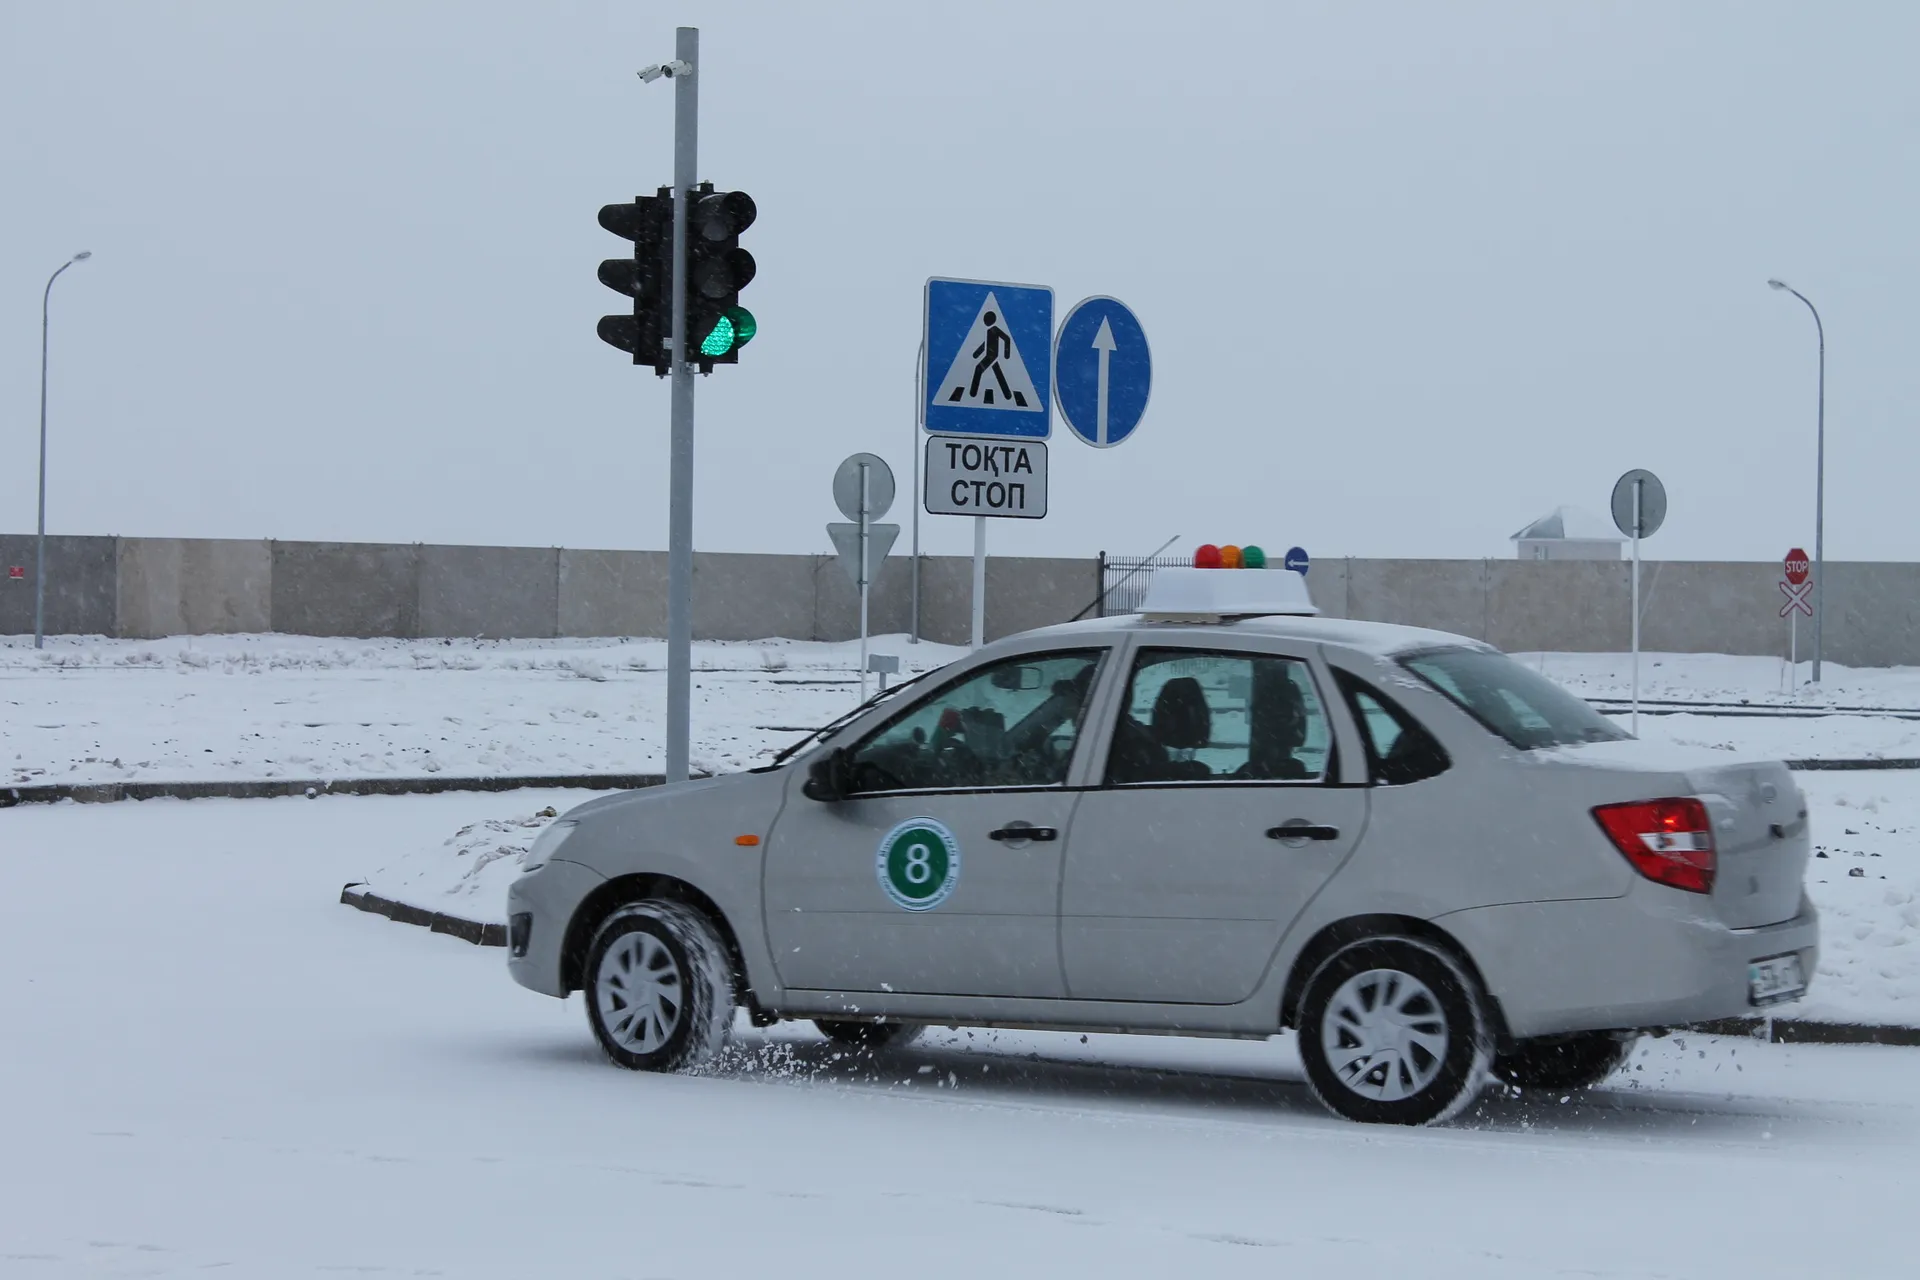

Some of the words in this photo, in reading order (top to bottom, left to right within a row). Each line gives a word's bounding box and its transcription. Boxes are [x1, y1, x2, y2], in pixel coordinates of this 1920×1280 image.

[945, 443, 1033, 477] ТОҚТА
[951, 479, 1025, 509] СТОП
[1786, 561, 1808, 573] STOP
[904, 843, 932, 884] 8
